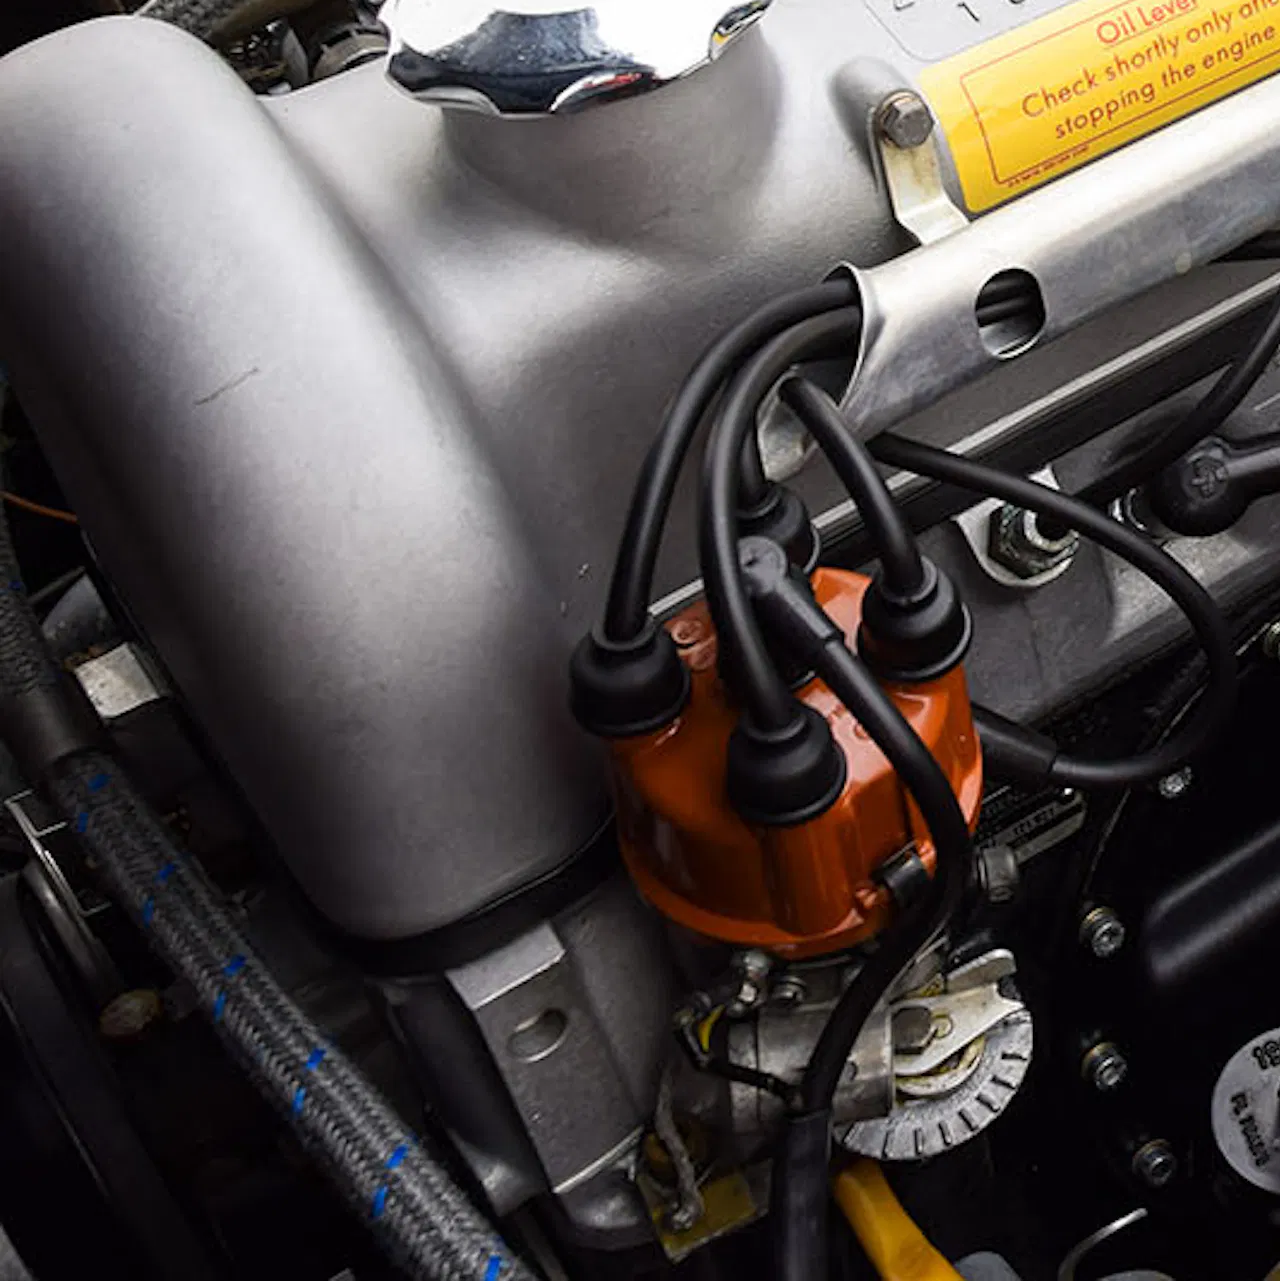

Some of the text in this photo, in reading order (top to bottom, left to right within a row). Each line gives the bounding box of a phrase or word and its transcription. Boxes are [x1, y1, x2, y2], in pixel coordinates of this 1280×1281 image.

[1021, 66, 1101, 118] Check
[1105, 32, 1181, 83] shortly
[1186, 9, 1235, 49] only
[1055, 22, 1278, 140] stopping the engine
[1096, 11, 1138, 46] Oil
